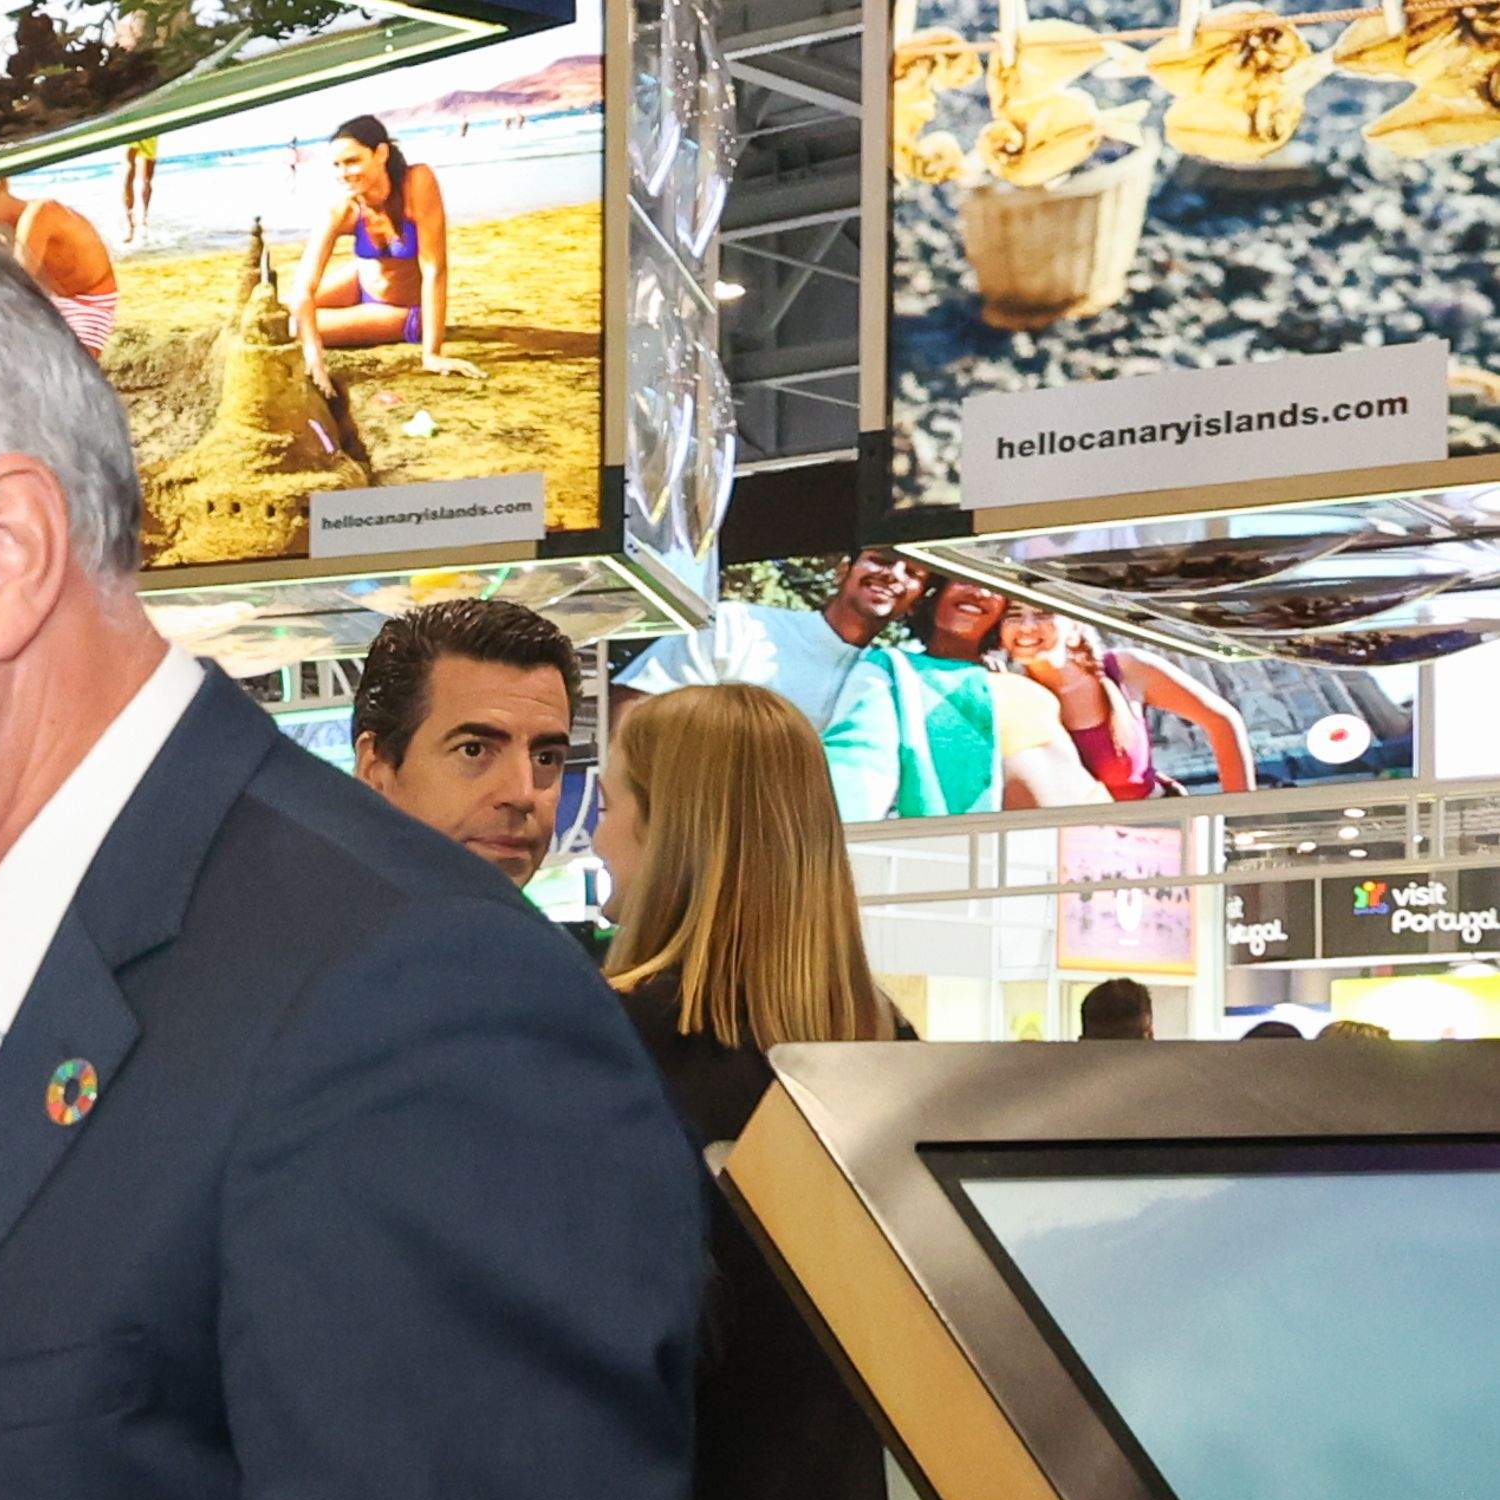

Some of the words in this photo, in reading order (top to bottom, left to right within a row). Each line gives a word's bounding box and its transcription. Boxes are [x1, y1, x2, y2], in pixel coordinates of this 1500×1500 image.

[996, 395, 1409, 460] hellocanaryislands.com
[321, 501, 533, 530] hellocanaryislands.com
[1391, 881, 1448, 907] visit
[1391, 906, 1500, 945] Portugal
